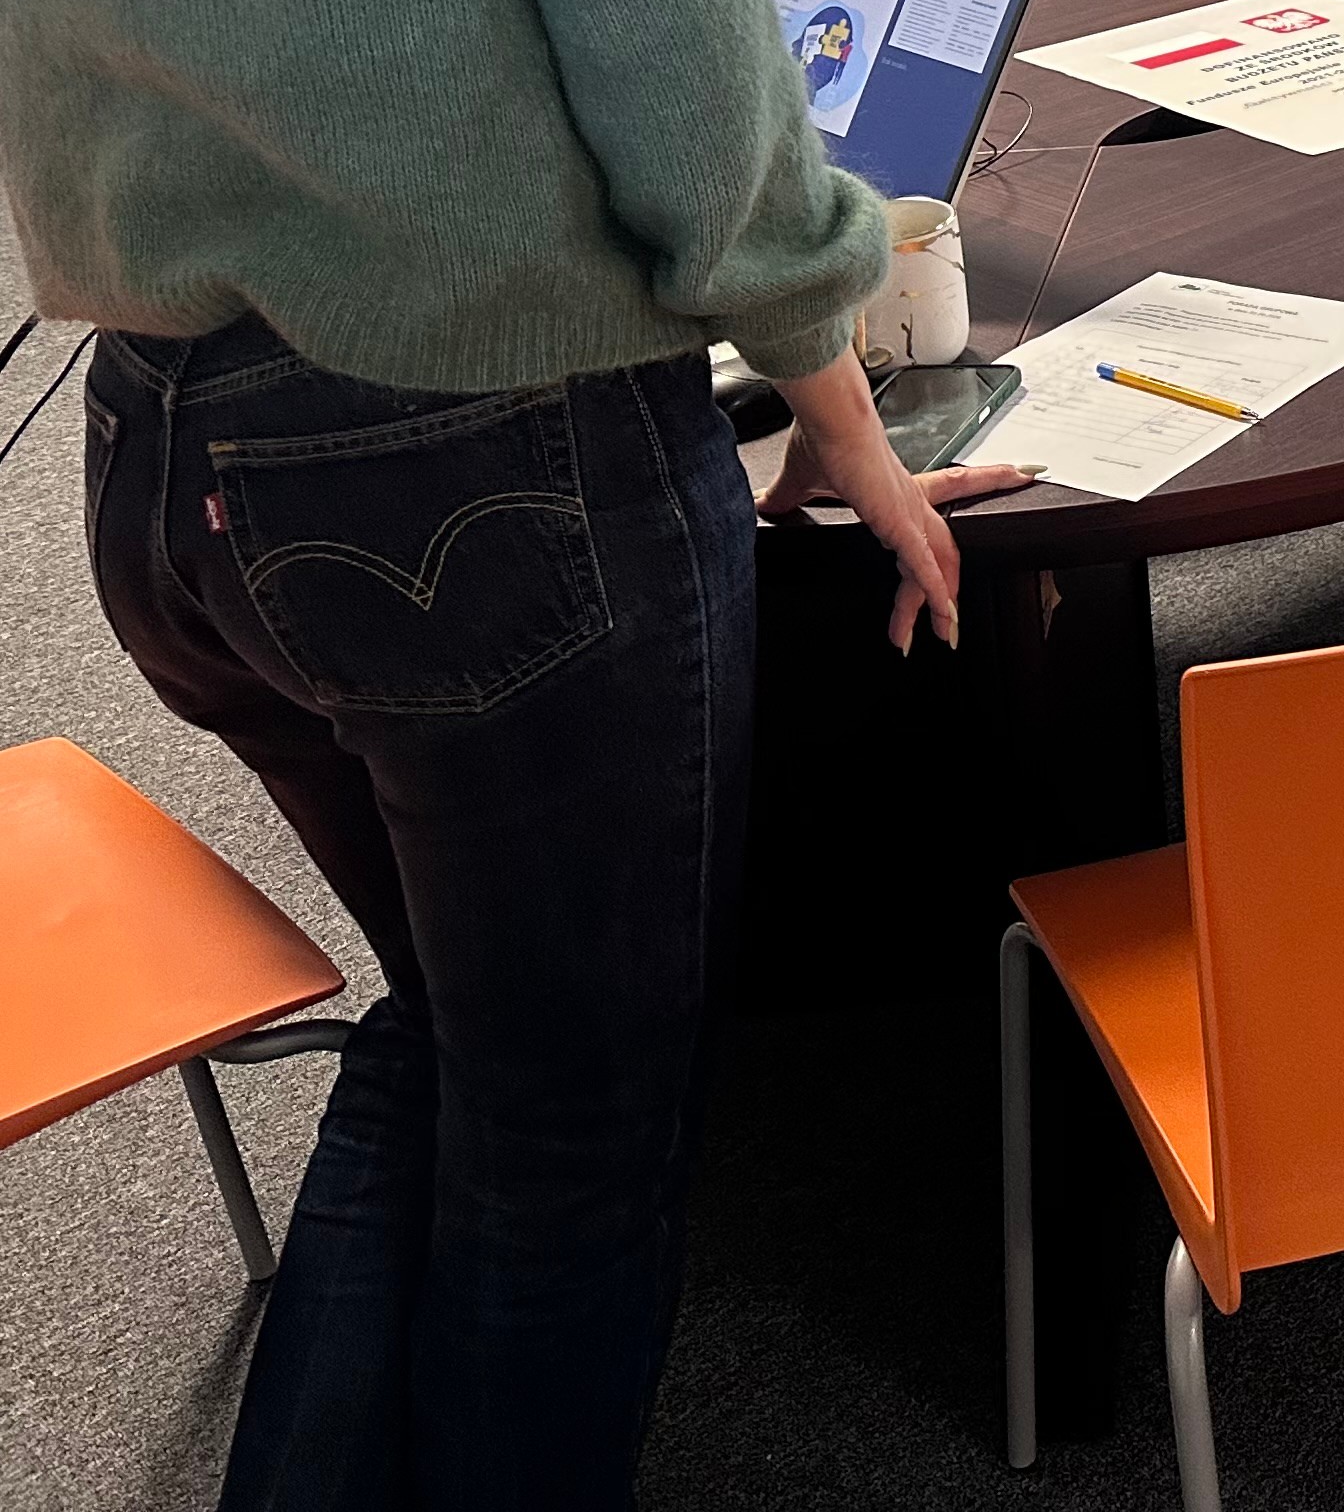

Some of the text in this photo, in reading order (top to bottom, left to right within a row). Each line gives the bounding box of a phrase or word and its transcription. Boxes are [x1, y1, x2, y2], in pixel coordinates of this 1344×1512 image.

[1200, 33, 1341, 73] DOFINANSOWANO
[1225, 60, 1299, 83] BUDŻETU
[1186, 85, 1256, 106] Fundusze
[1259, 62, 1341, 86] Europejskie
